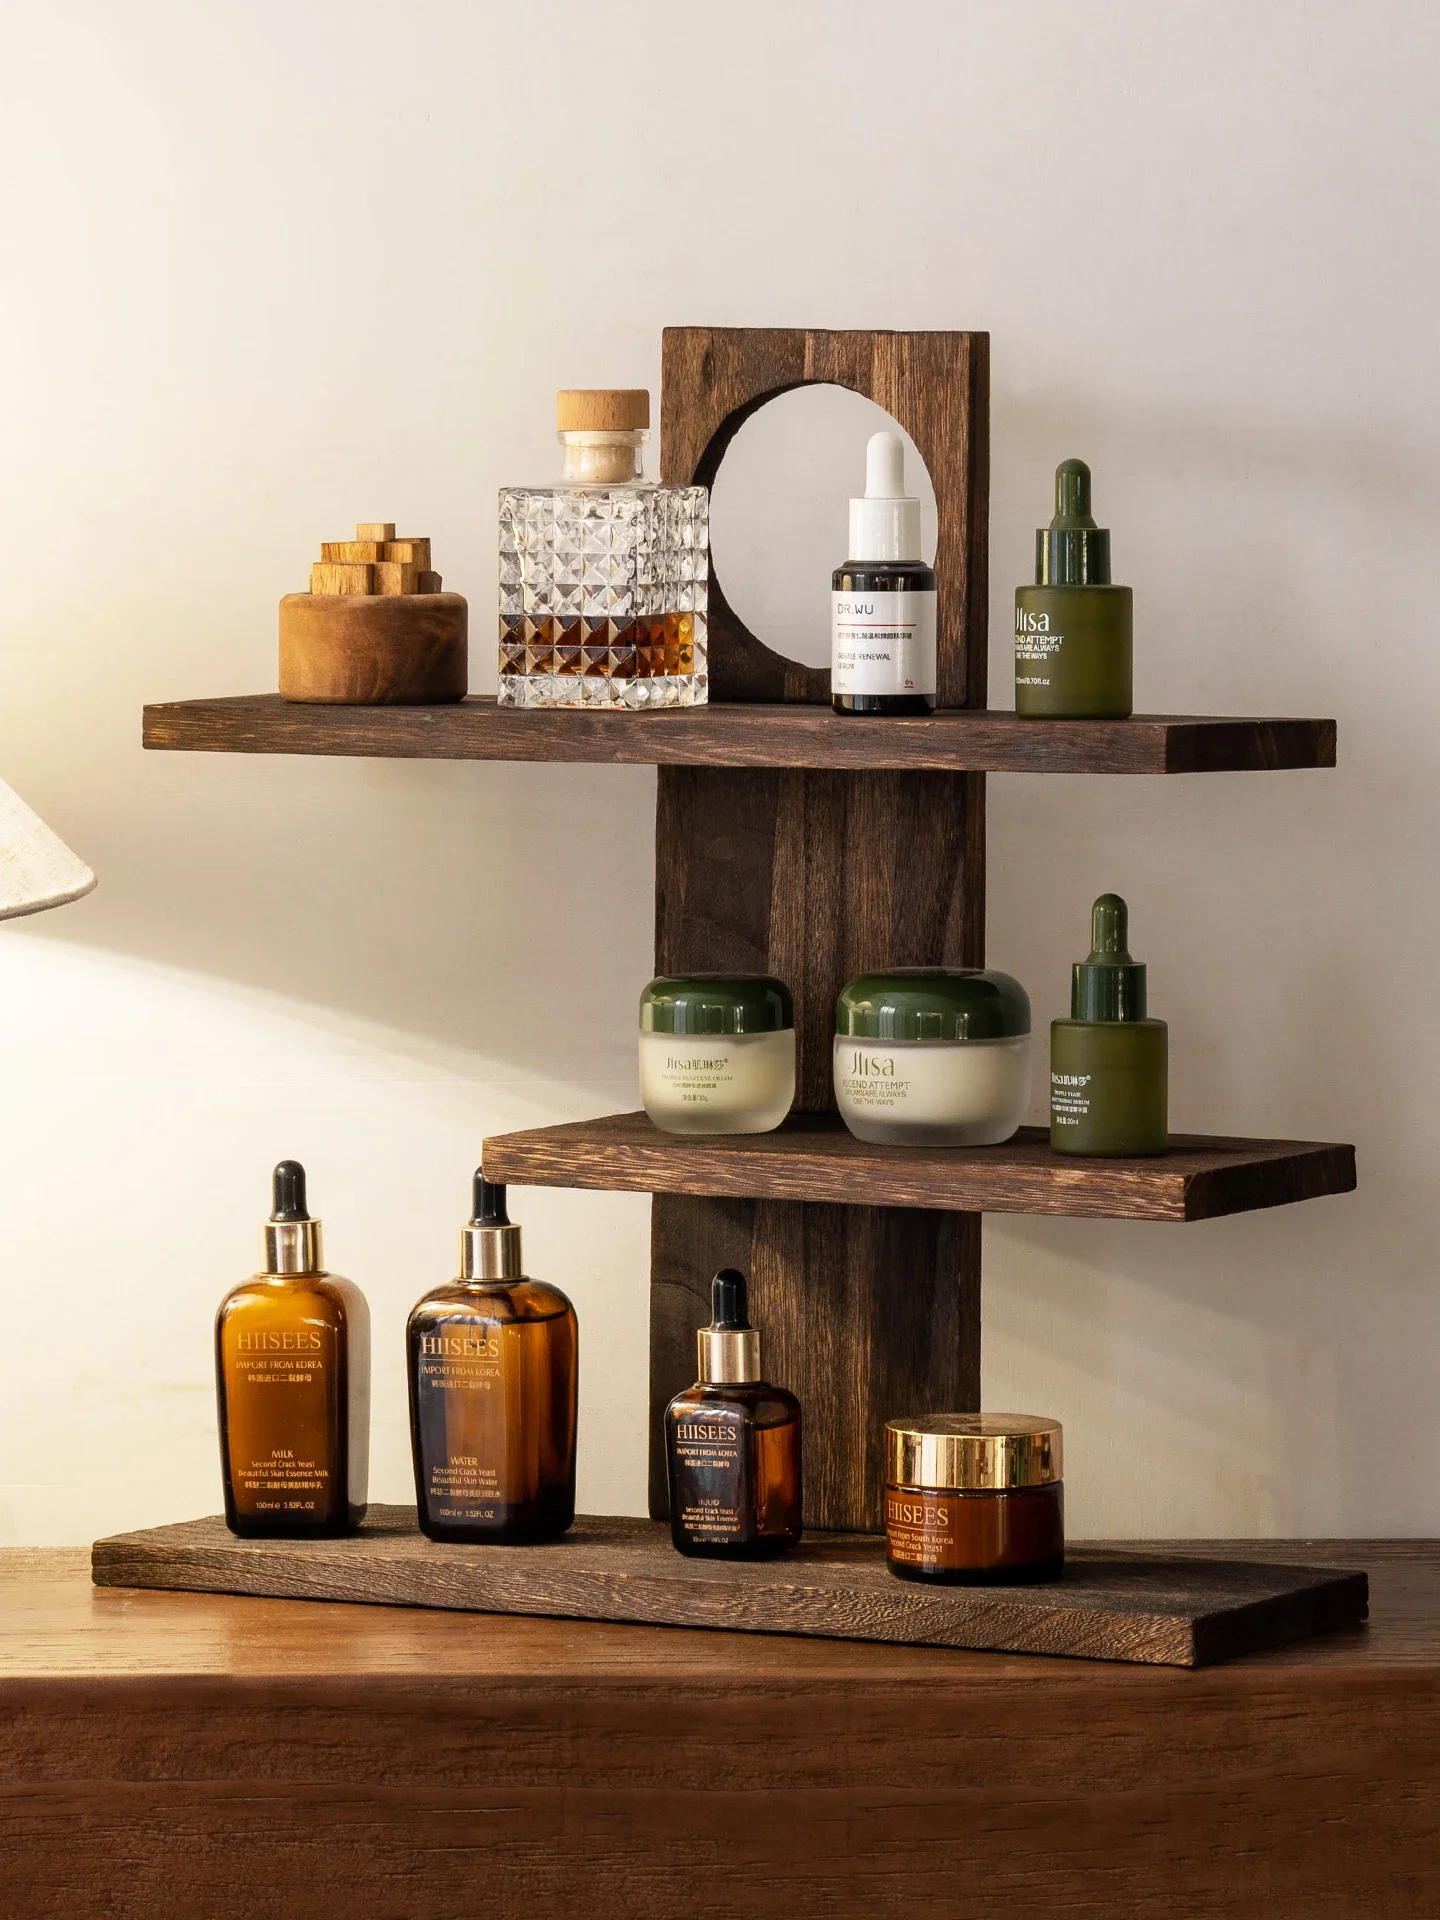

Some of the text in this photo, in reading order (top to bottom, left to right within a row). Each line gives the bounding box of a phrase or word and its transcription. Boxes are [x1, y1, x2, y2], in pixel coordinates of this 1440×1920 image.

[837, 604, 873, 615] DR.WU
[1026, 635, 1064, 645] ATTEMPT
[838, 652, 891, 661] GENTLE RENEWAL
[869, 1081, 910, 1090] ATTEMPT
[879, 1090, 907, 1098] ALWAYS
[236, 1331, 321, 1350] HIISEES
[422, 1336, 499, 1357] HIISEES
[236, 1361, 322, 1369] IMPORT FROM KOREA
[421, 1366, 500, 1377] IMPORT FROM KOREA
[677, 1424, 737, 1441] HIISEES
[271, 1449, 294, 1458] MILK
[451, 1456, 478, 1465] WATER
[433, 1467, 496, 1477] Second Crack Yeast
[432, 1476, 498, 1486] Beautiful Skin Water
[888, 1500, 949, 1526] HIISEES
[911, 1533, 930, 1543] South
[931, 1535, 954, 1545] Korea
[905, 1541, 922, 1551] Crack
[923, 1543, 943, 1553] Yeast
